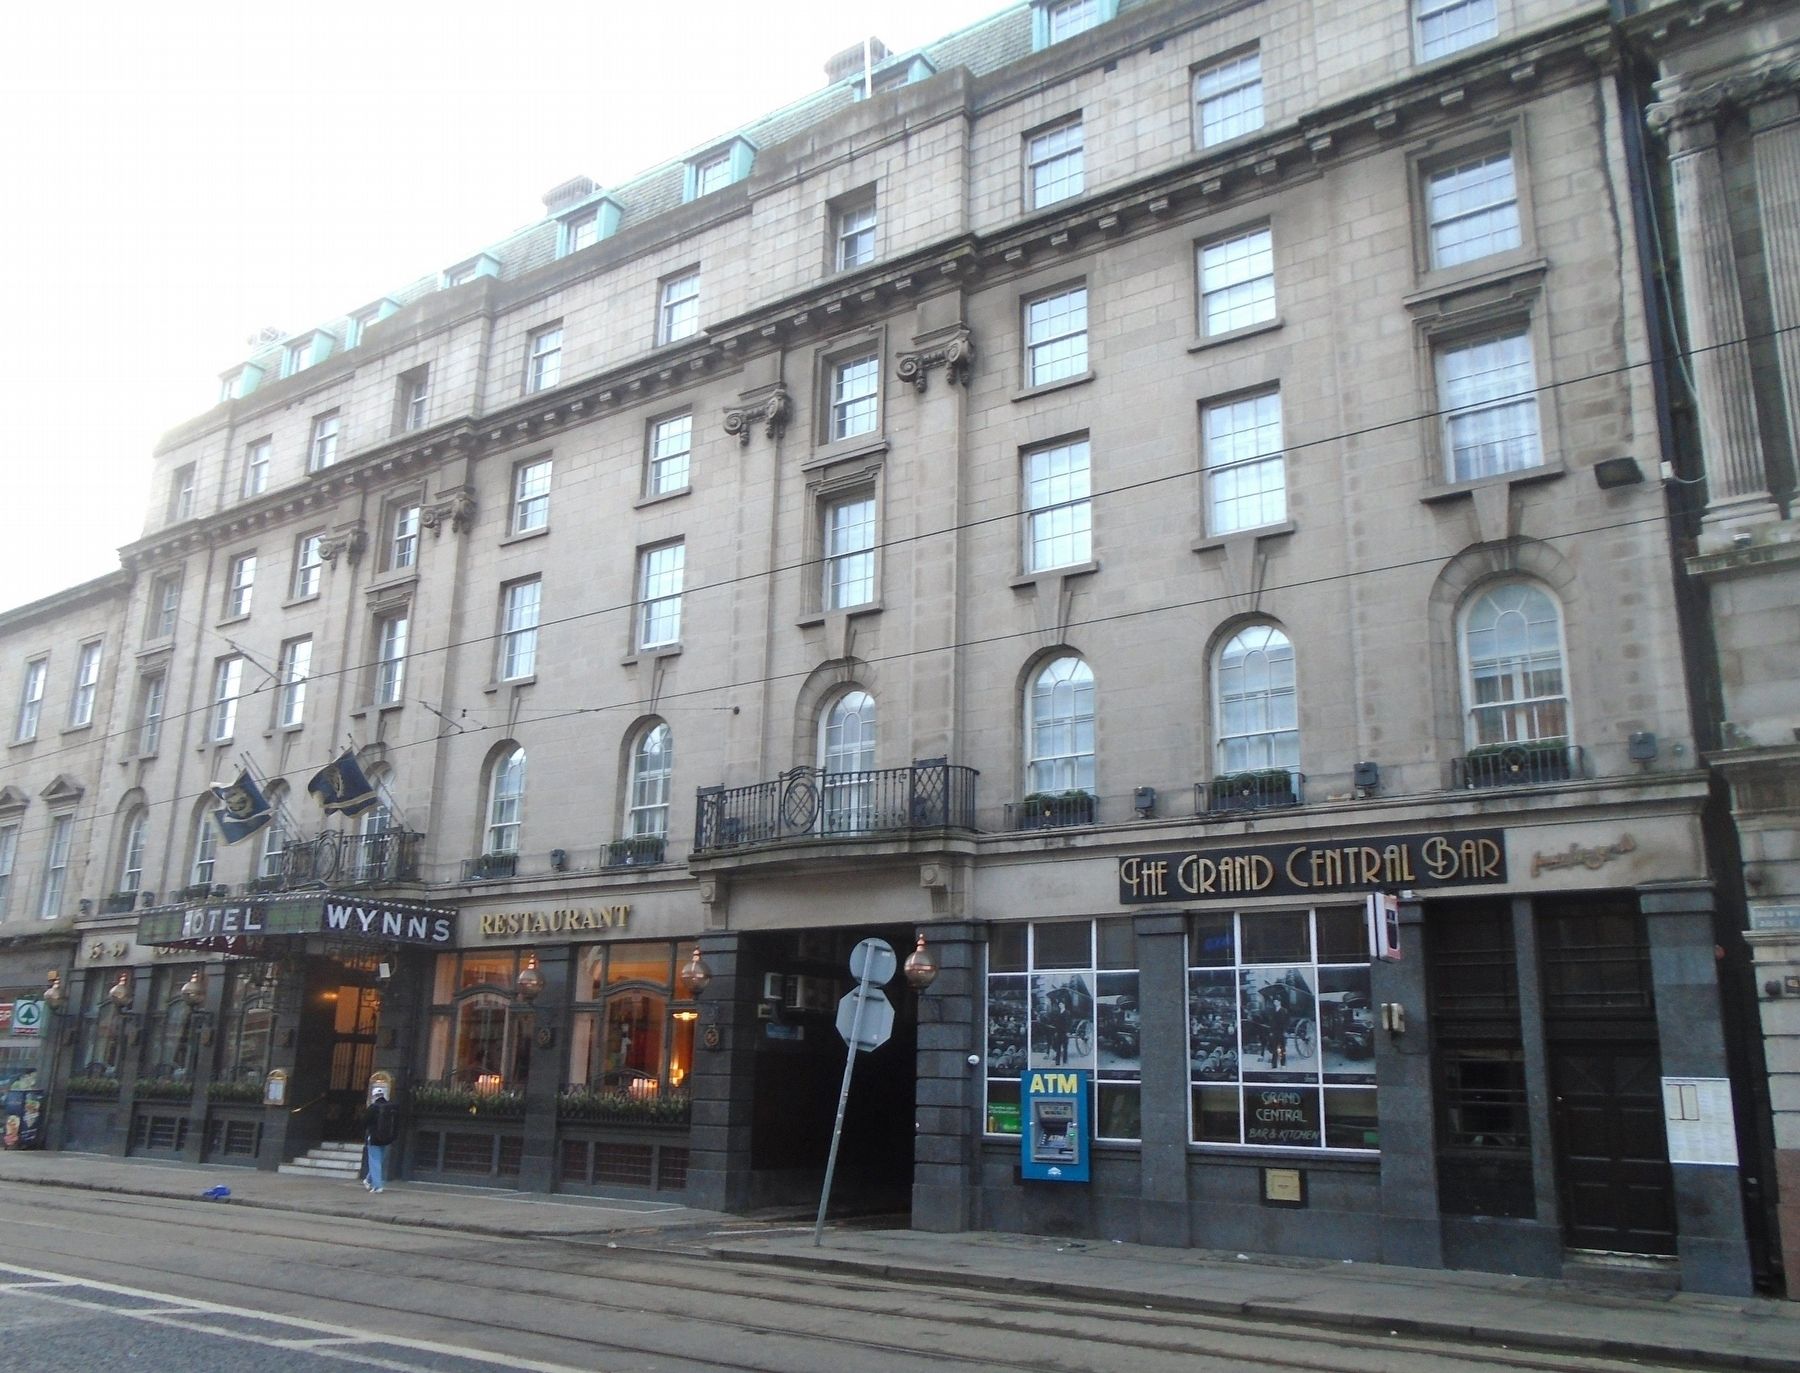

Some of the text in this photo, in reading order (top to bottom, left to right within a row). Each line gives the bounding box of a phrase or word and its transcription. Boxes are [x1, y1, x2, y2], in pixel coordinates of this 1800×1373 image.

[1120, 836, 1501, 897] THE GRAND CENTRAL BAR
[327, 903, 450, 941] WYNNS
[479, 904, 632, 935] RESTAURANT
[1029, 1073, 1078, 1094] ATM
[1261, 1091, 1301, 1105] GRAND
[1255, 1108, 1307, 1122] CENTRAL
[1249, 1128, 1320, 1141] BAR & KITCHEN
